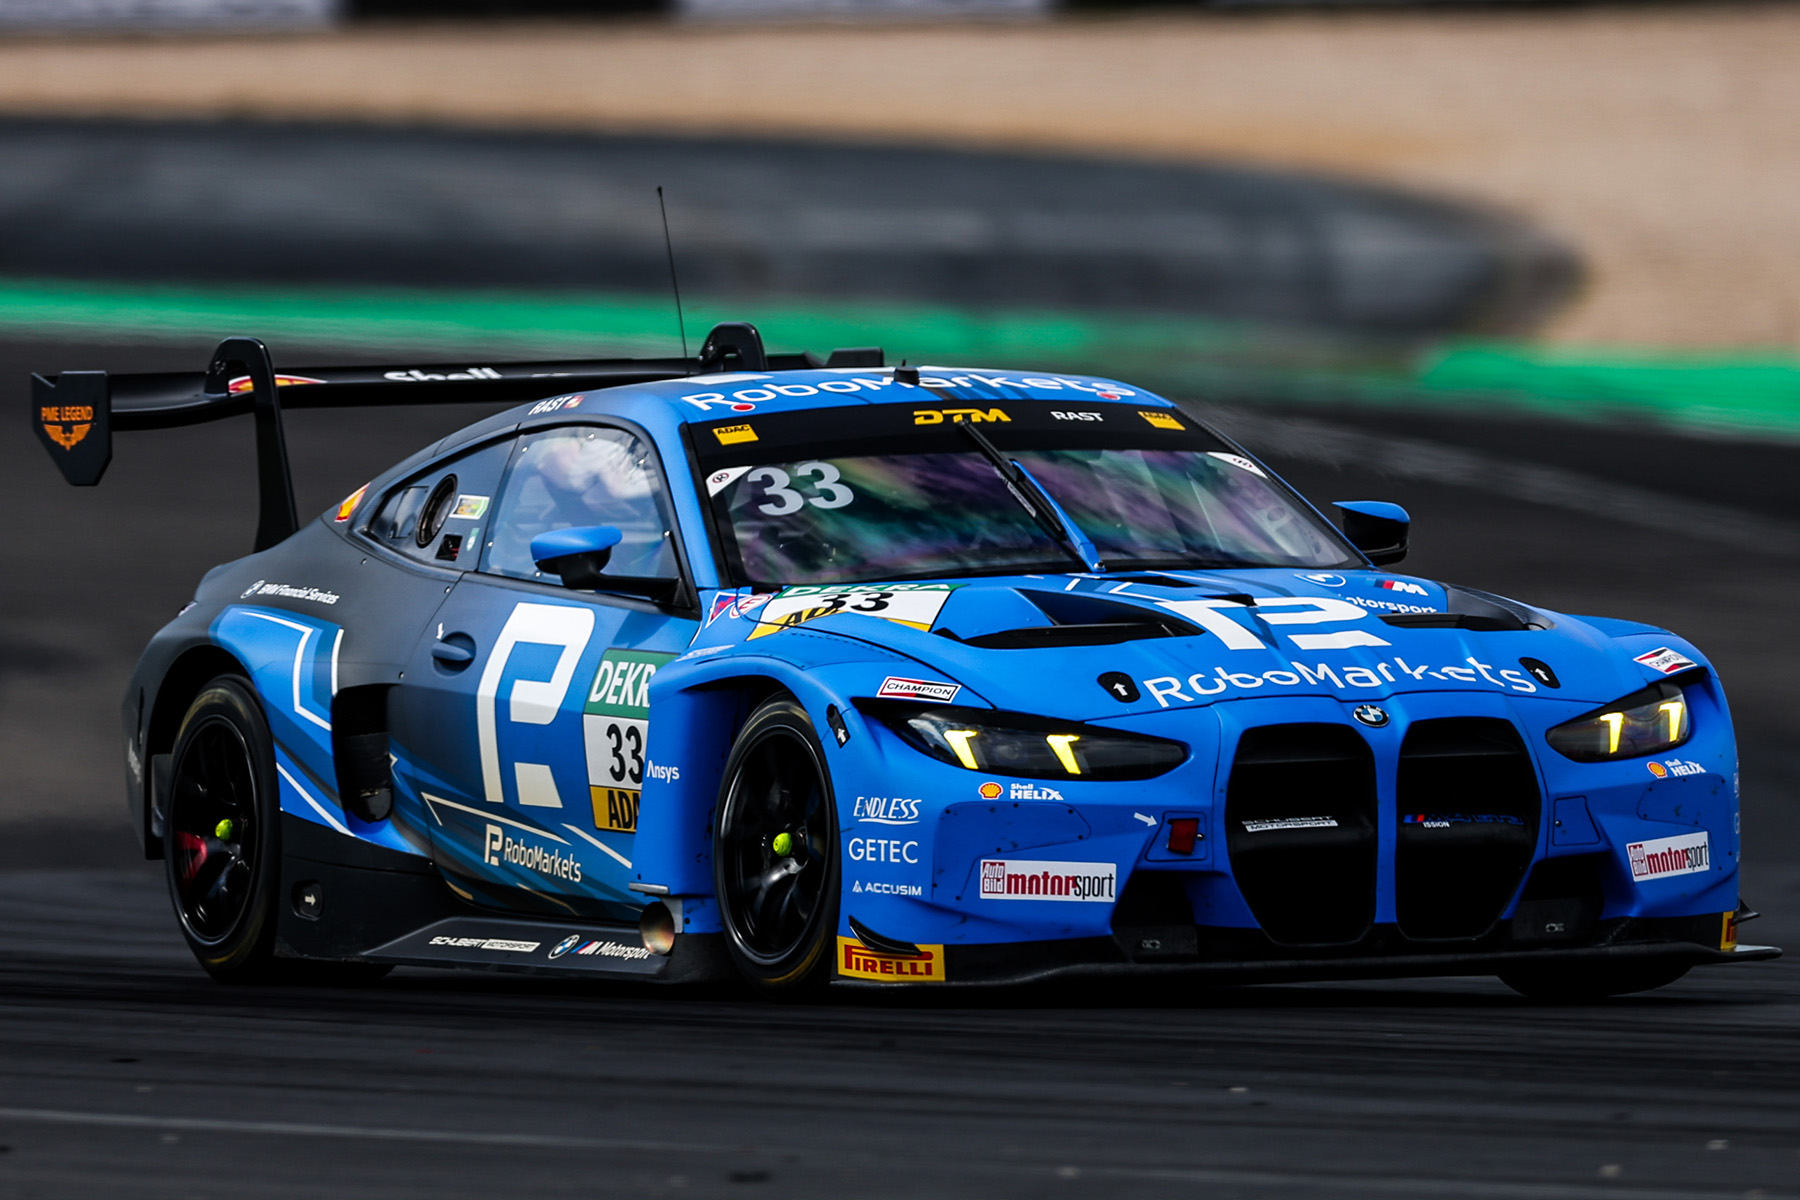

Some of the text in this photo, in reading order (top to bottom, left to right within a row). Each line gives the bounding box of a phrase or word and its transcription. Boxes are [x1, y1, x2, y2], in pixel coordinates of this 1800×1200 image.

[61, 405, 94, 421] LEGEND
[528, 395, 572, 416] RAST
[913, 408, 1012, 425] DTM
[1050, 411, 1104, 422] RAST
[717, 424, 751, 435] ADAC
[747, 462, 854, 516] 33
[305, 587, 341, 605] Services
[782, 584, 951, 598] DEKRA
[818, 592, 894, 612] 33
[886, 682, 953, 696] CHAMPION
[1143, 656, 1538, 708] RoboMarkets
[606, 723, 644, 784] 33
[646, 760, 680, 784] Ansys
[1670, 761, 1707, 776] HELIX
[1010, 787, 1064, 800] HELIX
[853, 796, 922, 820] ENDLESS
[848, 838, 919, 864] GETEC
[503, 837, 582, 883] RoboMarkets
[983, 862, 1005, 879] Auto
[865, 882, 922, 896] ACCUSIM
[983, 878, 1004, 892] Bild
[844, 944, 935, 976] PIRELLI
